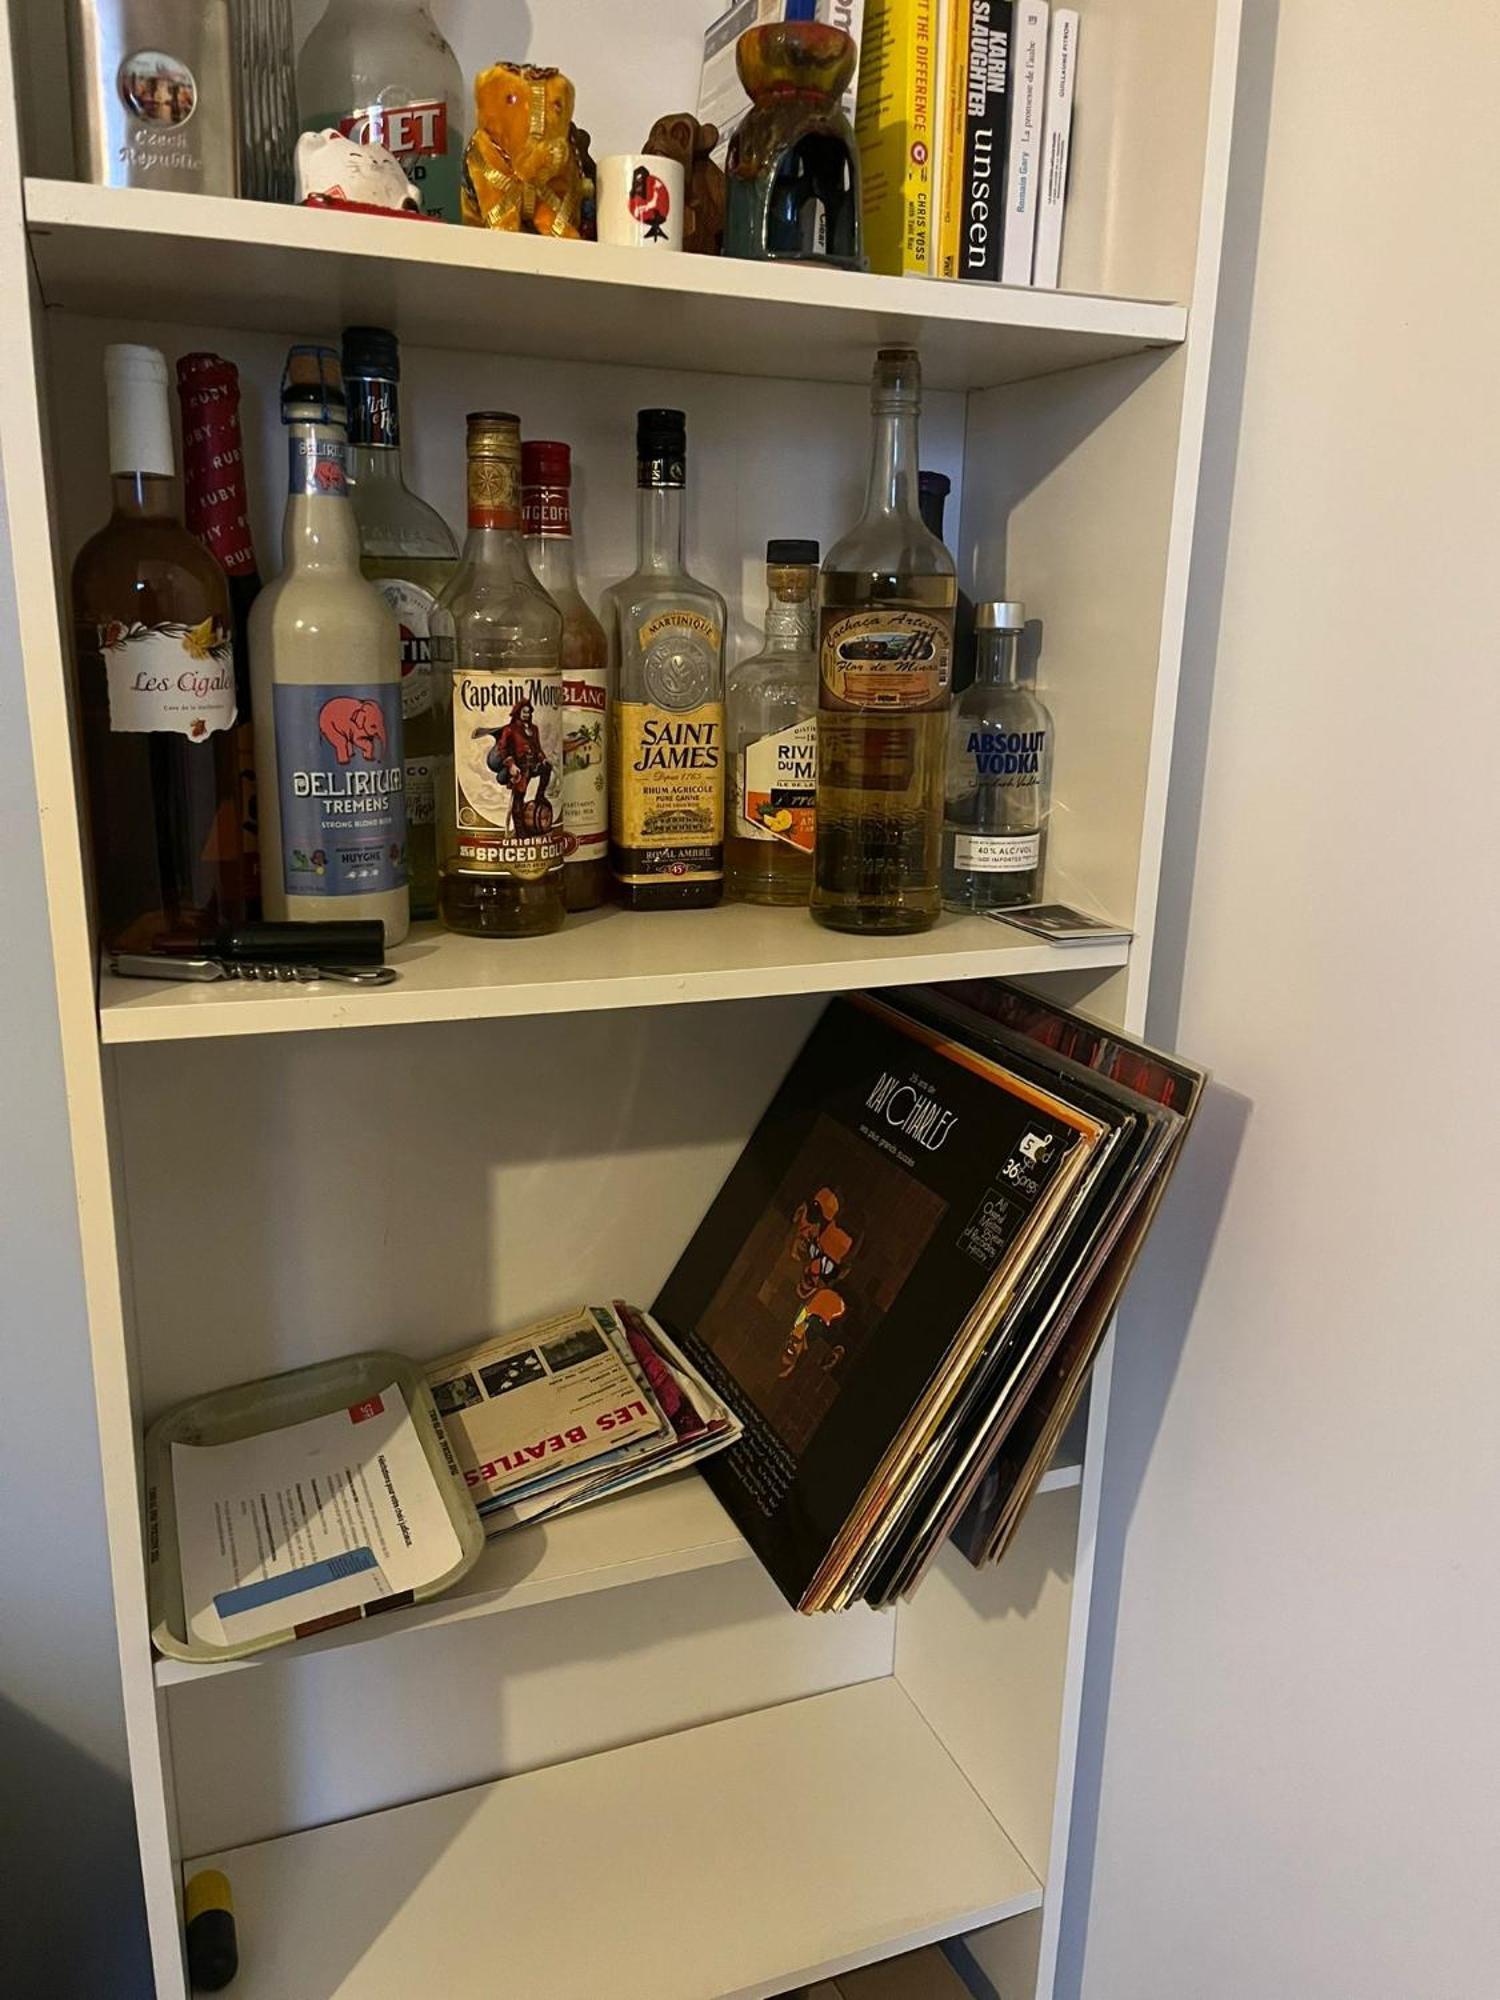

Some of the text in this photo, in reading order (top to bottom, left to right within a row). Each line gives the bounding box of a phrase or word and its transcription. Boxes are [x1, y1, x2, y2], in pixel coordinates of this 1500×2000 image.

[917, 15, 929, 38] THE
[968, 1, 990, 117] SLAUGHTER
[987, 30, 1007, 94] KARIN
[914, 43, 929, 134] DIFFERENCE
[1027, 71, 1034, 82] de
[1024, 85, 1034, 128] promesse
[135, 129, 187, 148] Czech
[1022, 130, 1030, 142] La
[118, 147, 202, 170] Republic
[1016, 151, 1029, 212] Romain Gary
[917, 192, 927, 228] CHRIS
[969, 128, 993, 268] unseen
[915, 230, 926, 261] VOSS
[649, 615, 713, 637] MARTINIQUE
[836, 661, 938, 672] Flor de Minas
[129, 671, 170, 692] Les
[461, 679, 525, 712] Captain
[641, 720, 719, 746] SAINT
[967, 731, 1046, 753] ABSOLUT
[633, 746, 719, 772] JAMES
[778, 761, 793, 771] DU
[975, 752, 1039, 774] VODKA
[293, 767, 402, 797] DELIRIUM
[643, 784, 713, 795] RHUM AGRICOLE
[323, 797, 389, 814] TREMENS
[321, 820, 352, 829] STRONG
[502, 835, 553, 847] ORIGINAL
[475, 845, 537, 863] SPICED
[865, 1071, 959, 1151] RAY CHARLES
[1002, 1158, 1040, 1194] 36 Songs
[596, 1400, 649, 1431] LES
[463, 1426, 557, 1488] BEATLES
